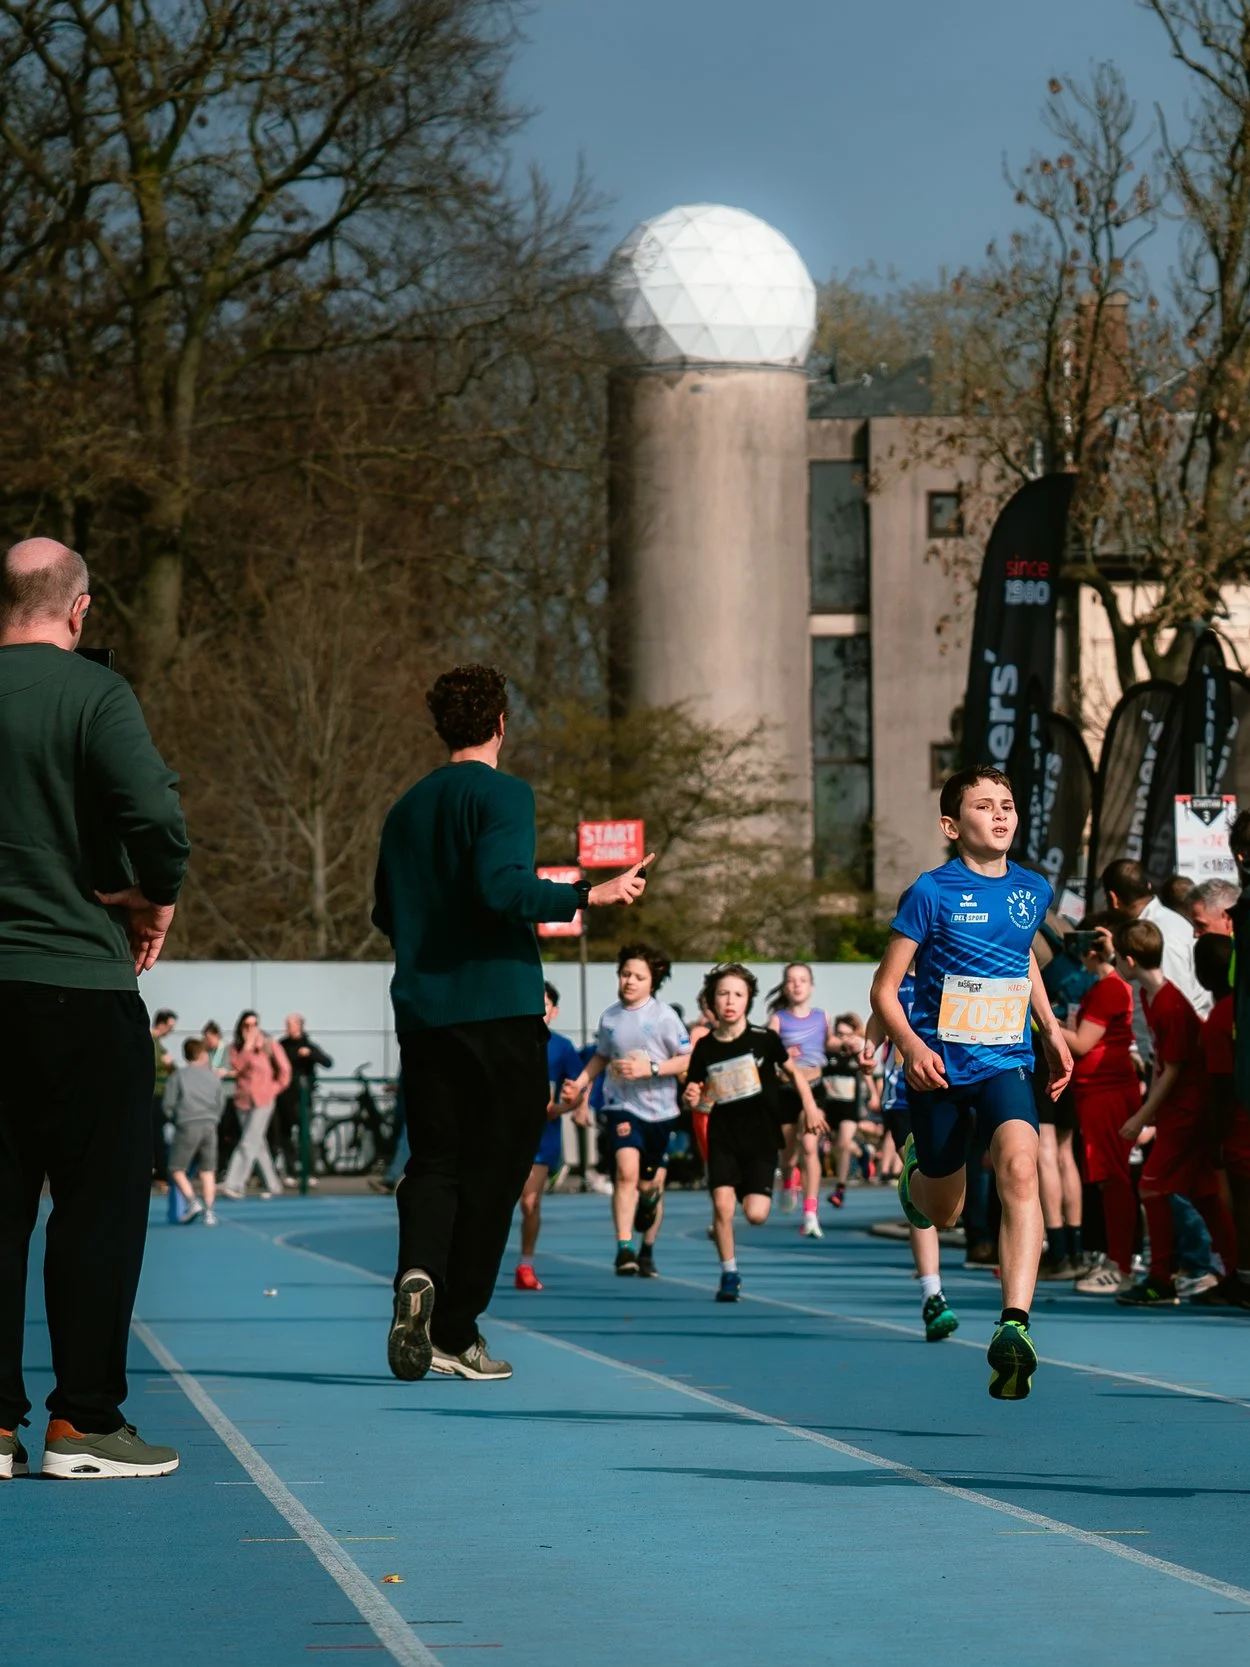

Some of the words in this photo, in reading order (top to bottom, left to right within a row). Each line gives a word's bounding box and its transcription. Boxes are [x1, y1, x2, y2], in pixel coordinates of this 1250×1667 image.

[1005, 554, 1049, 577] since
[984, 649, 1018, 772] ers'
[1126, 708, 1164, 862] unners'
[581, 823, 637, 846] START
[1006, 890, 1037, 905] VACBL
[1007, 983, 1028, 992] KIDS
[947, 996, 1022, 1031] 7053
